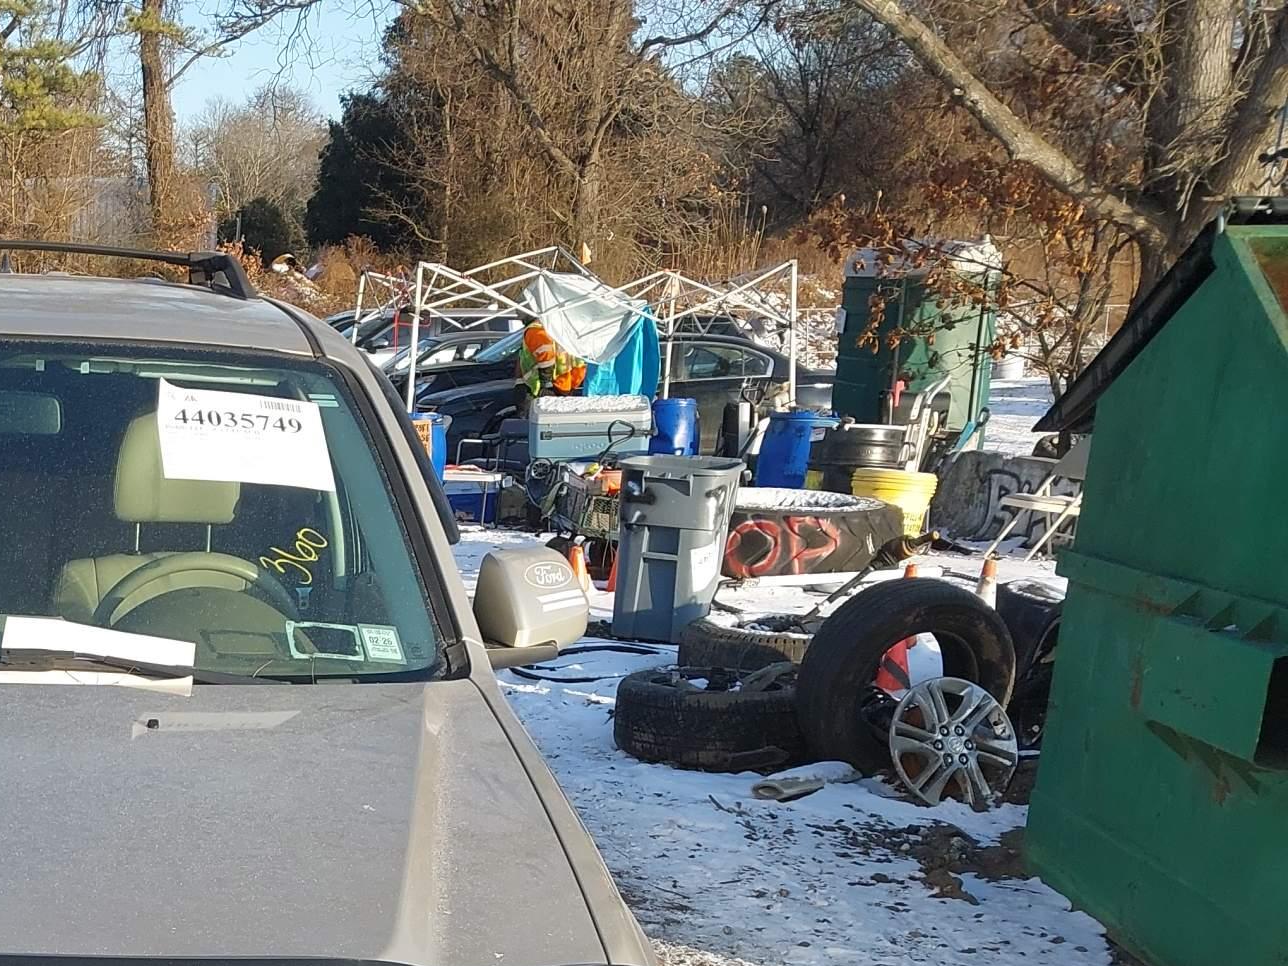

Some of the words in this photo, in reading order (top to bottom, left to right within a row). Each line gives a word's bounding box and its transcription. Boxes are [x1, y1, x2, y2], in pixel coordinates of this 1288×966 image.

[174, 408, 303, 434] 44035749
[259, 527, 329, 585] 360
[533, 565, 566, 585] Ford
